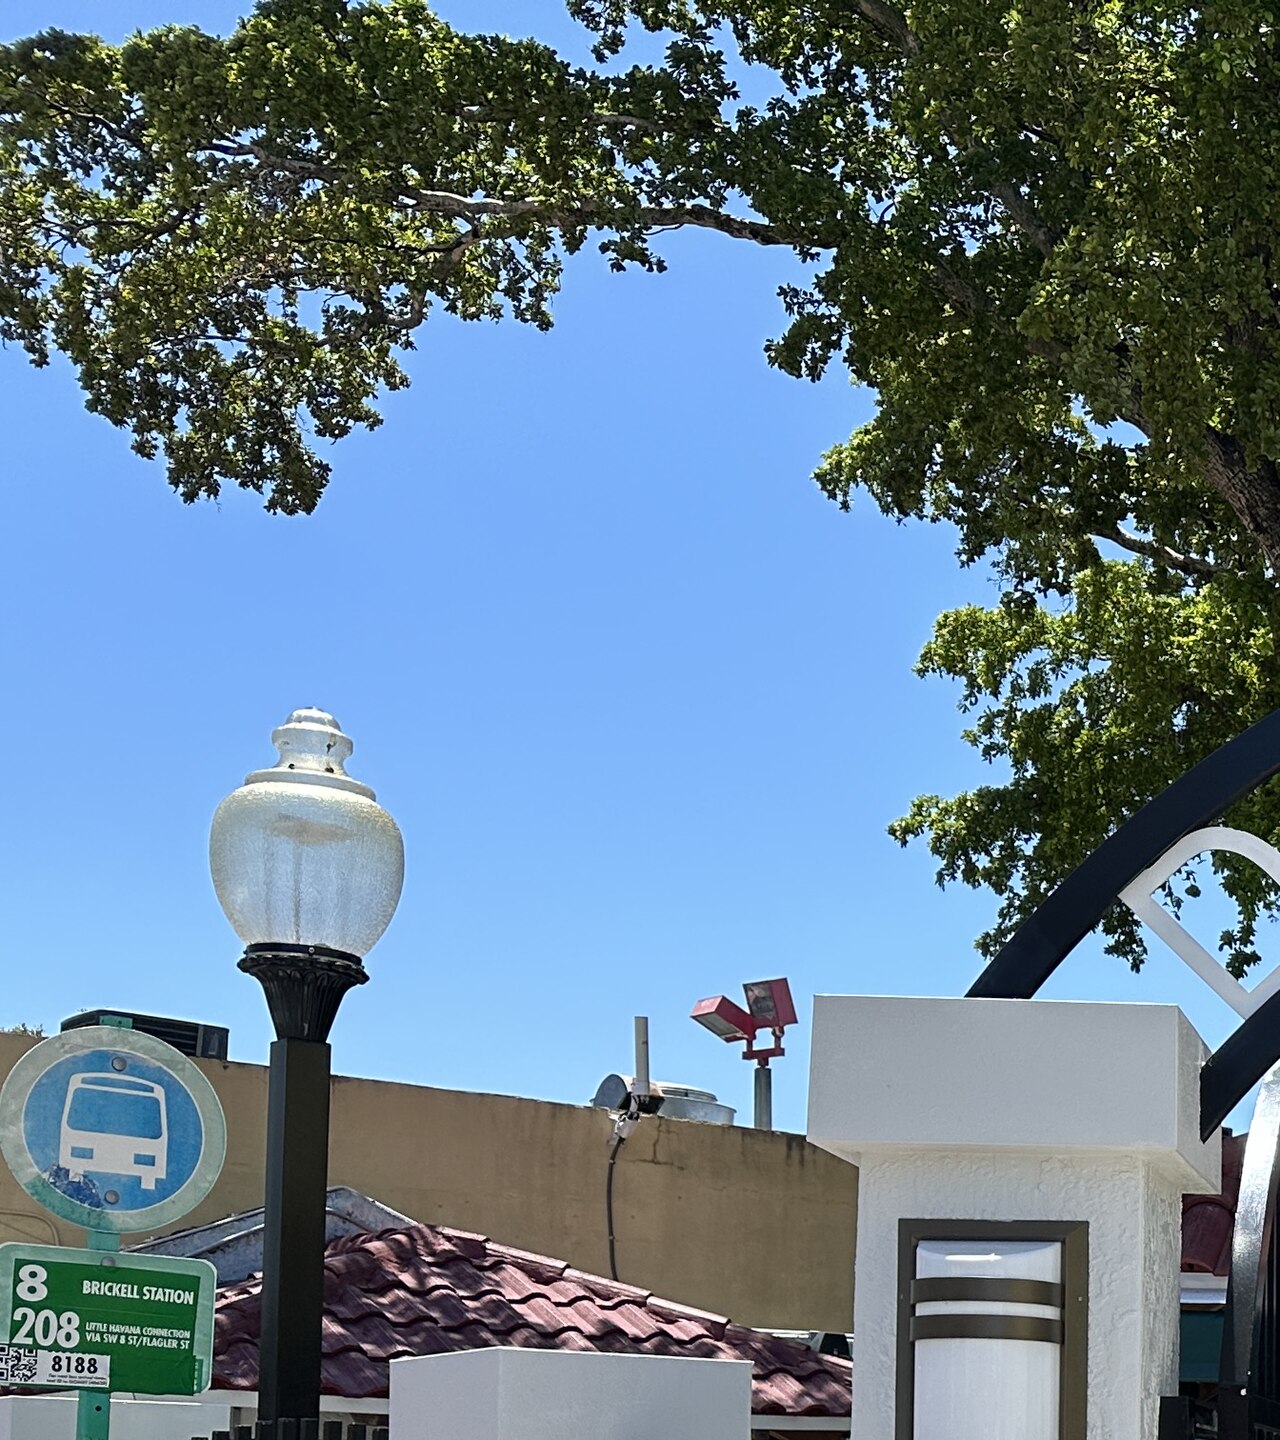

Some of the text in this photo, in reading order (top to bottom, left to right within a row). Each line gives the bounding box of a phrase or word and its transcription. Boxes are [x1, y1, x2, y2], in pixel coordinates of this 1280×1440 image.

[16, 1264, 194, 1305] 8 BRICKELL STATION
[11, 1307, 80, 1348] 208
[85, 1322, 191, 1339] LITTLE HAVANA CONNECTION
[86, 1332, 101, 1342] VIA
[103, 1334, 118, 1344] SW
[119, 1335, 126, 1345] 8
[179, 1340, 190, 1350] ST
[51, 1355, 99, 1374] 8188
